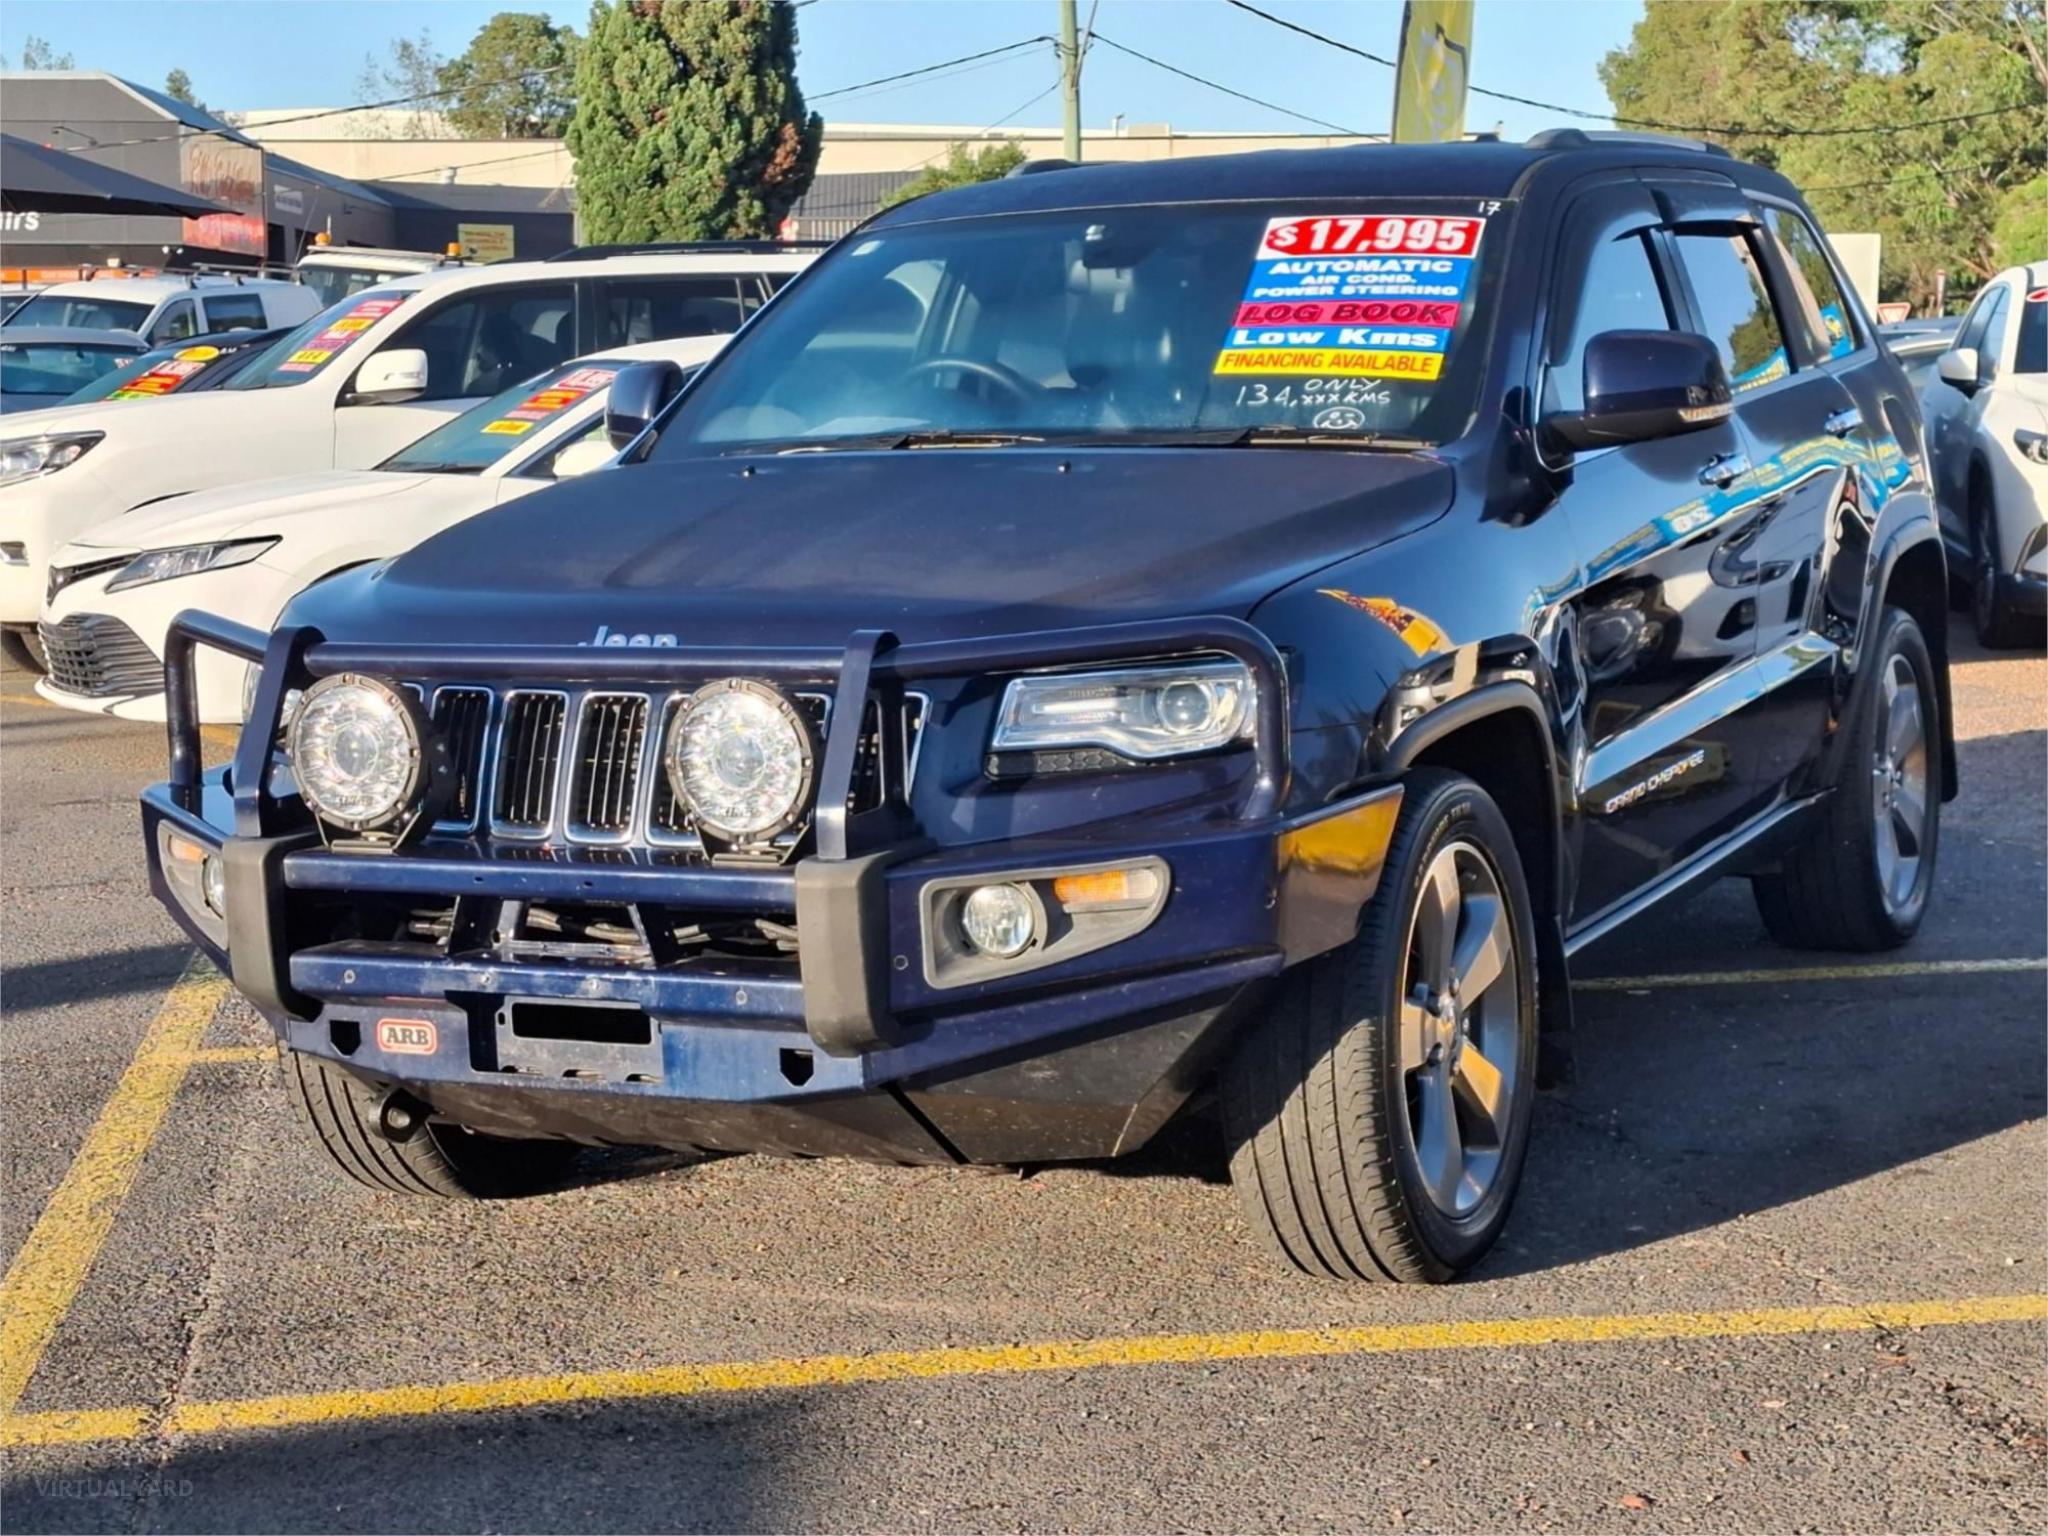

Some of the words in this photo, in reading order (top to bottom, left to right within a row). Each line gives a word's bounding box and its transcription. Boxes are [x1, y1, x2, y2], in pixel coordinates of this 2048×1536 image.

[1478, 200, 1501, 216] 17
[1269, 259, 1454, 276] AUTOMATIC
[1300, 274, 1341, 285] AIR
[1346, 273, 1417, 285] COND.
[1253, 286, 1335, 298] POWER
[1341, 284, 1459, 296] STEERING
[1240, 304, 1324, 323] LOG
[1331, 302, 1453, 323] BOOK
[1232, 329, 1325, 346] Low
[1338, 328, 1438, 348] Kms
[1222, 353, 1324, 368] FINANCING
[1329, 354, 1433, 373] AVAILABLE
[386, 1027, 429, 1046] ARB
